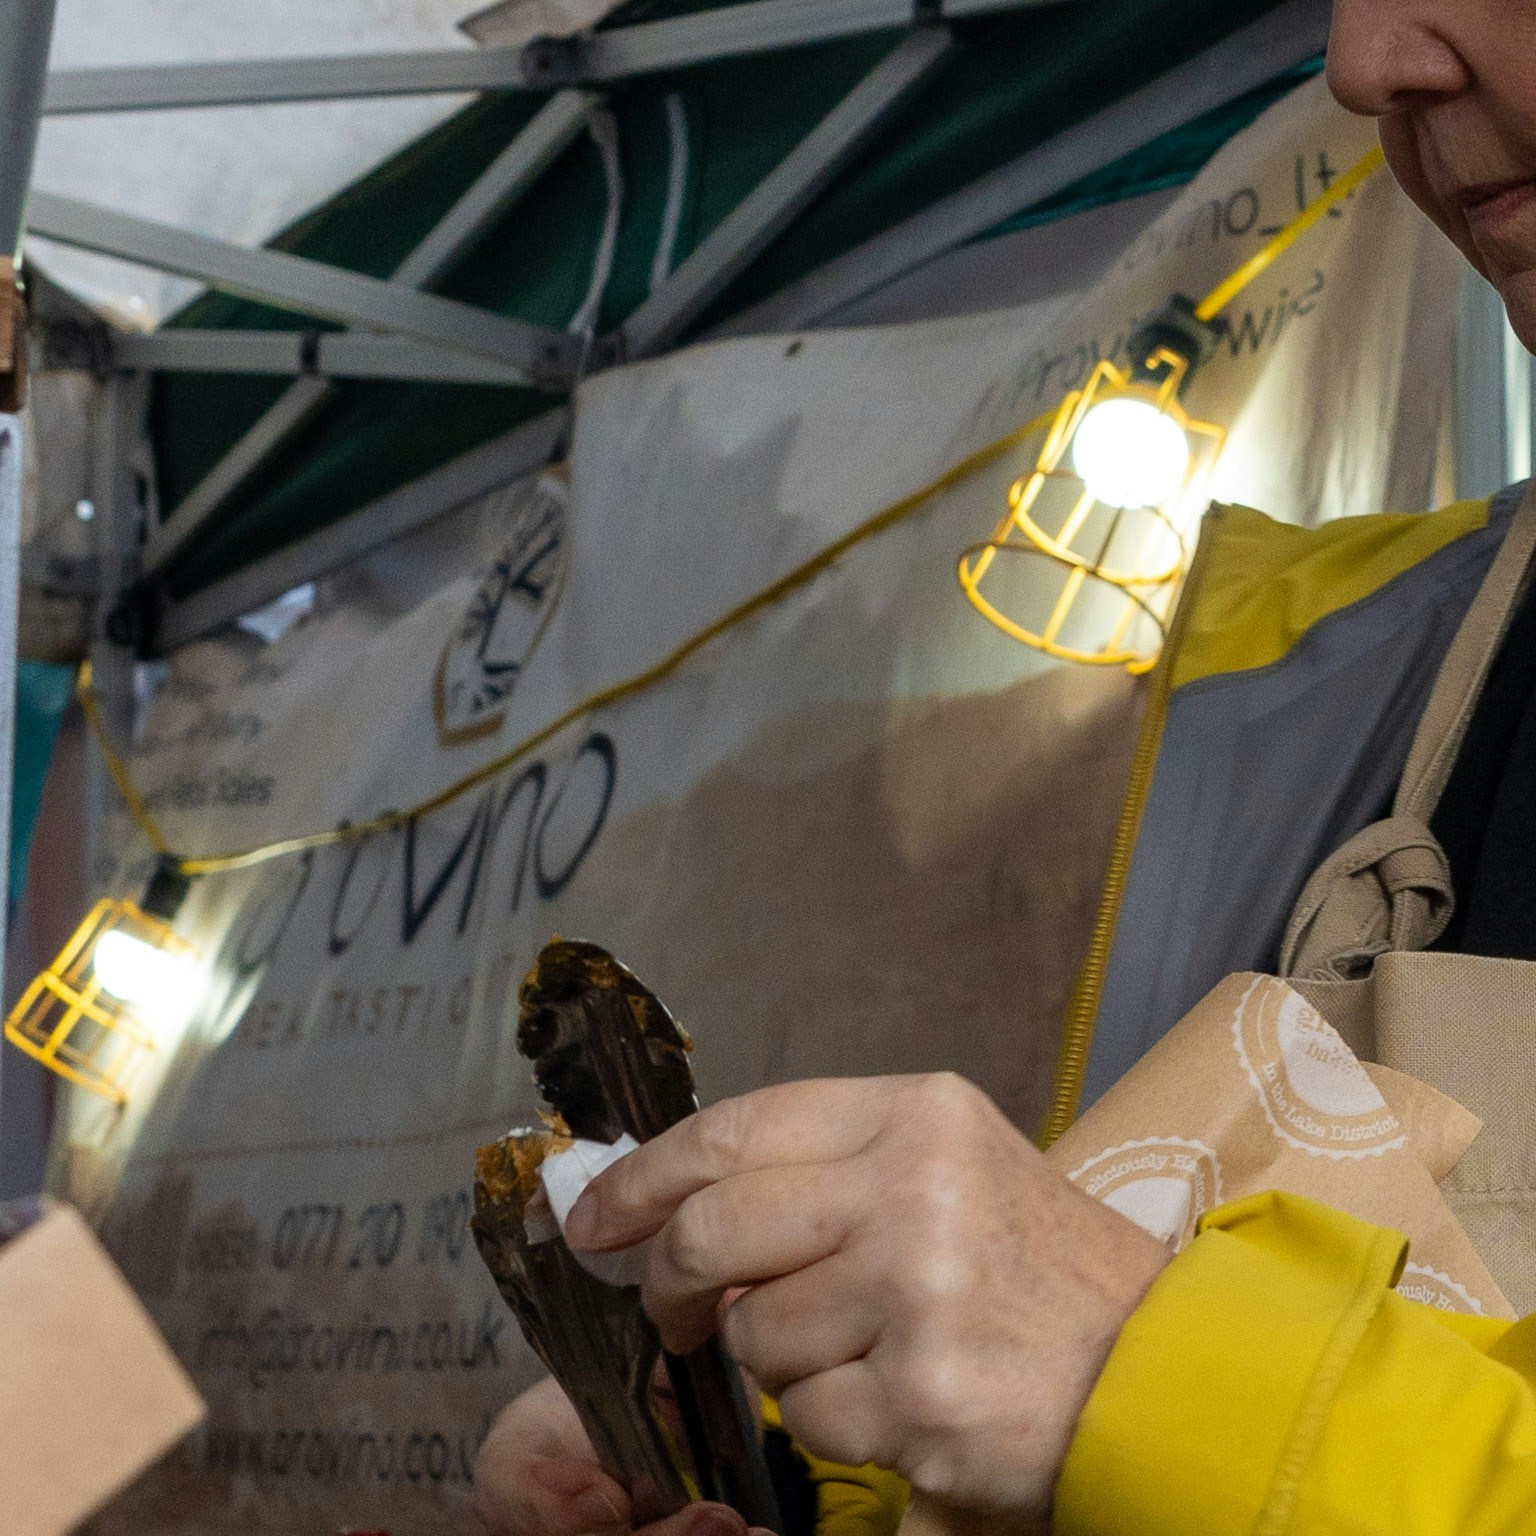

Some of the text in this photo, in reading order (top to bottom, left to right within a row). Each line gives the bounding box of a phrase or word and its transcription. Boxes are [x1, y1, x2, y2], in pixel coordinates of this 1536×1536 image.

[1286, 1107, 1326, 1138] Lake
[1330, 1115, 1400, 1142] District
[1085, 1152, 1170, 1197] eliciously
